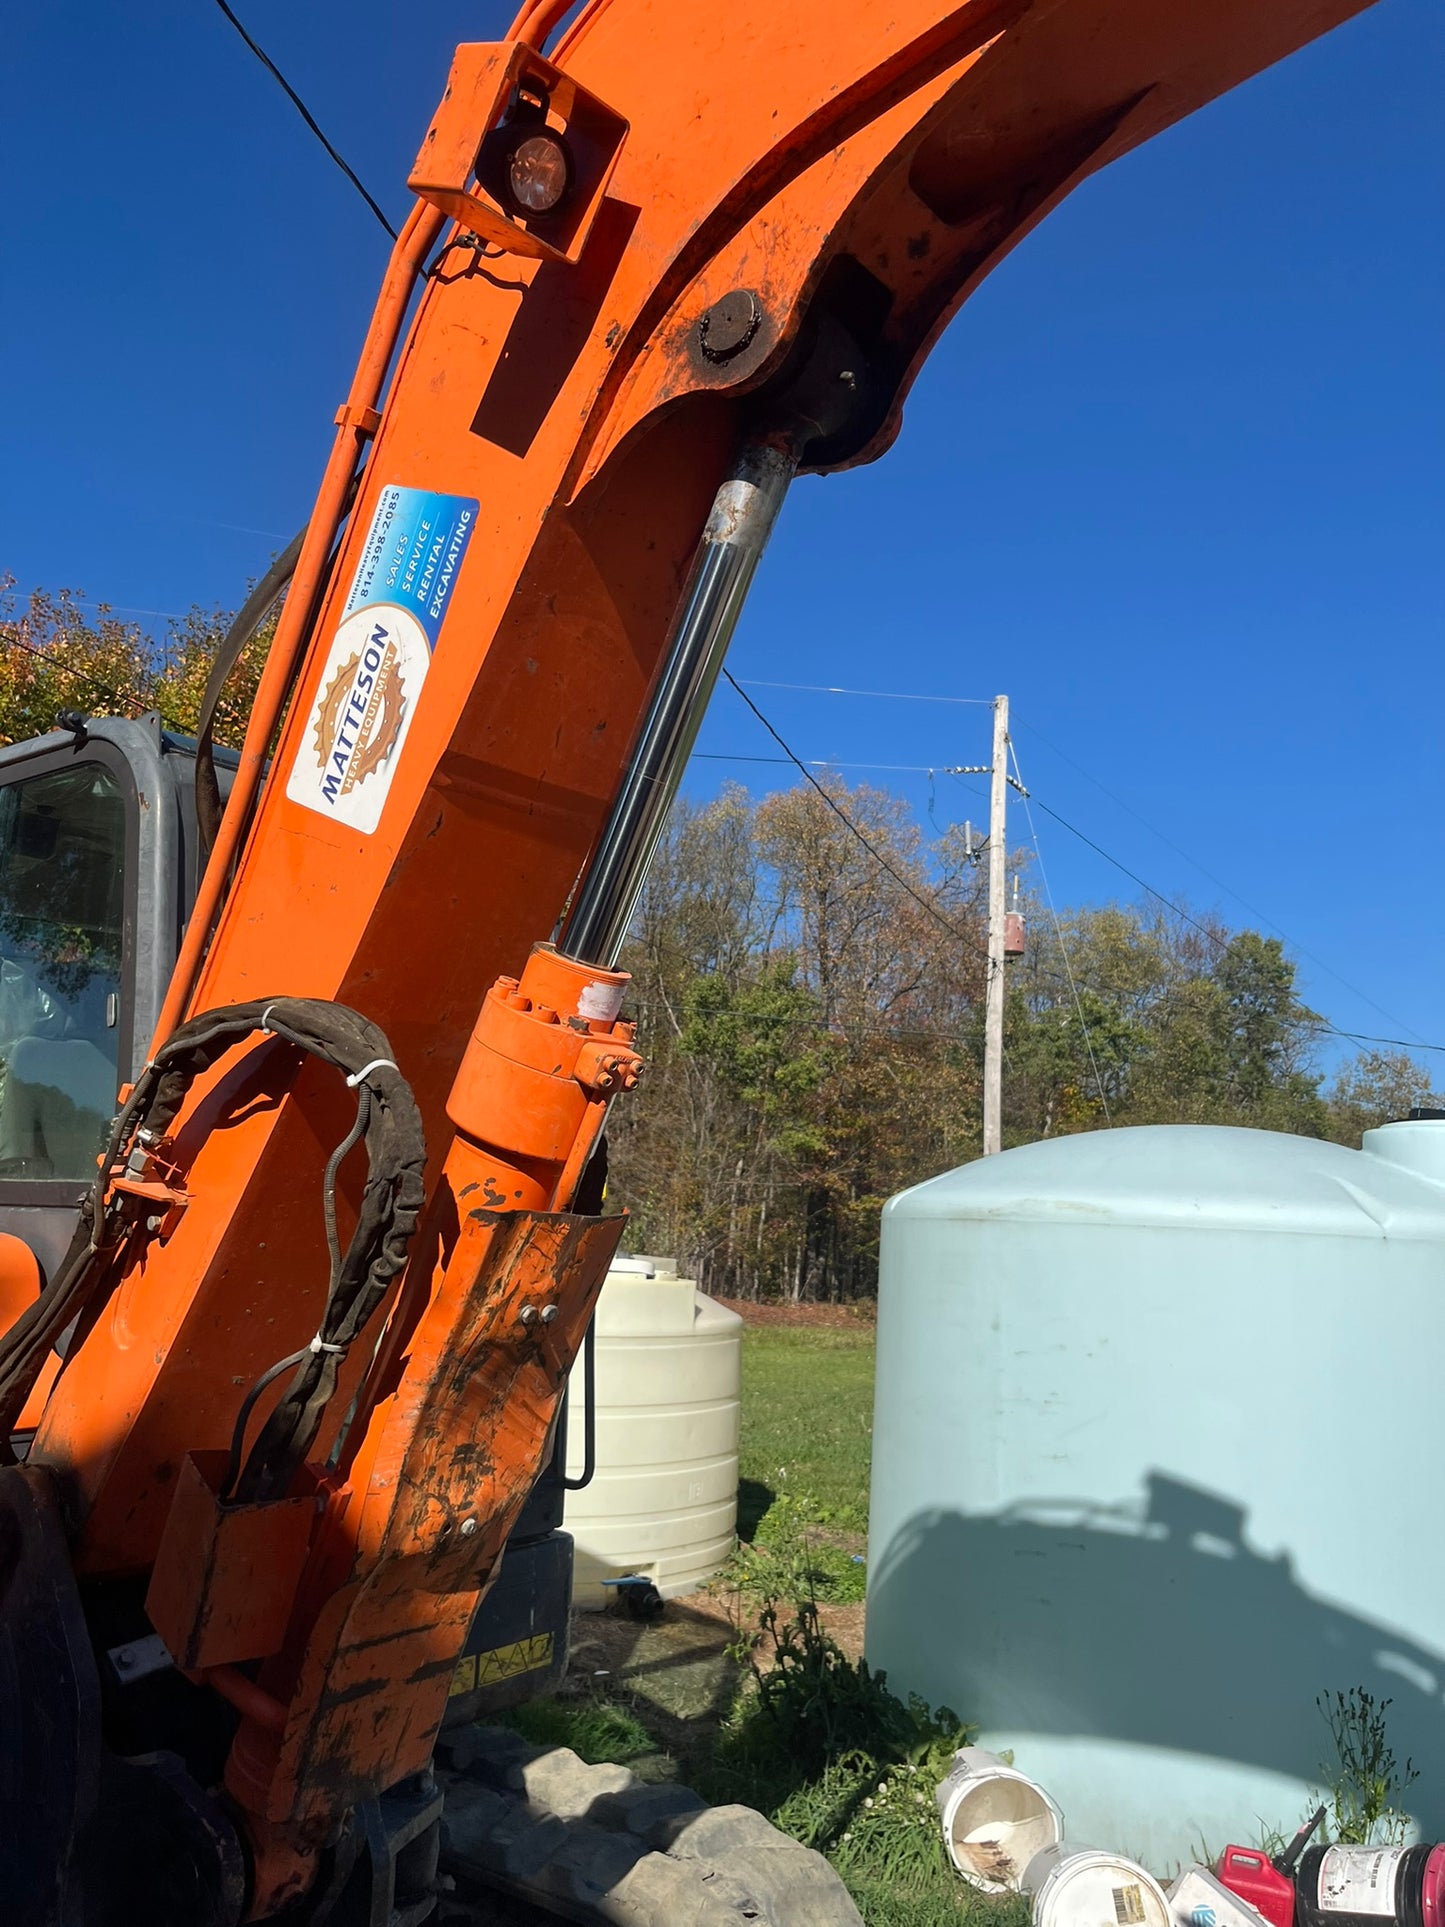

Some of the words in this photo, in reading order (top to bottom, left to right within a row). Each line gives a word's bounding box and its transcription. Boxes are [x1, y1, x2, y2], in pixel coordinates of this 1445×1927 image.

[360, 491, 401, 597] 814-398-2085
[386, 533, 409, 588] SALES
[401, 519, 431, 592] SERVICE
[417, 534, 445, 602] RENTAL
[430, 510, 472, 619] EXCAVATING
[321, 623, 390, 805] MATTESON
[344, 738, 367, 790] HEAVY
[361, 651, 395, 738] EQUIPMENT
